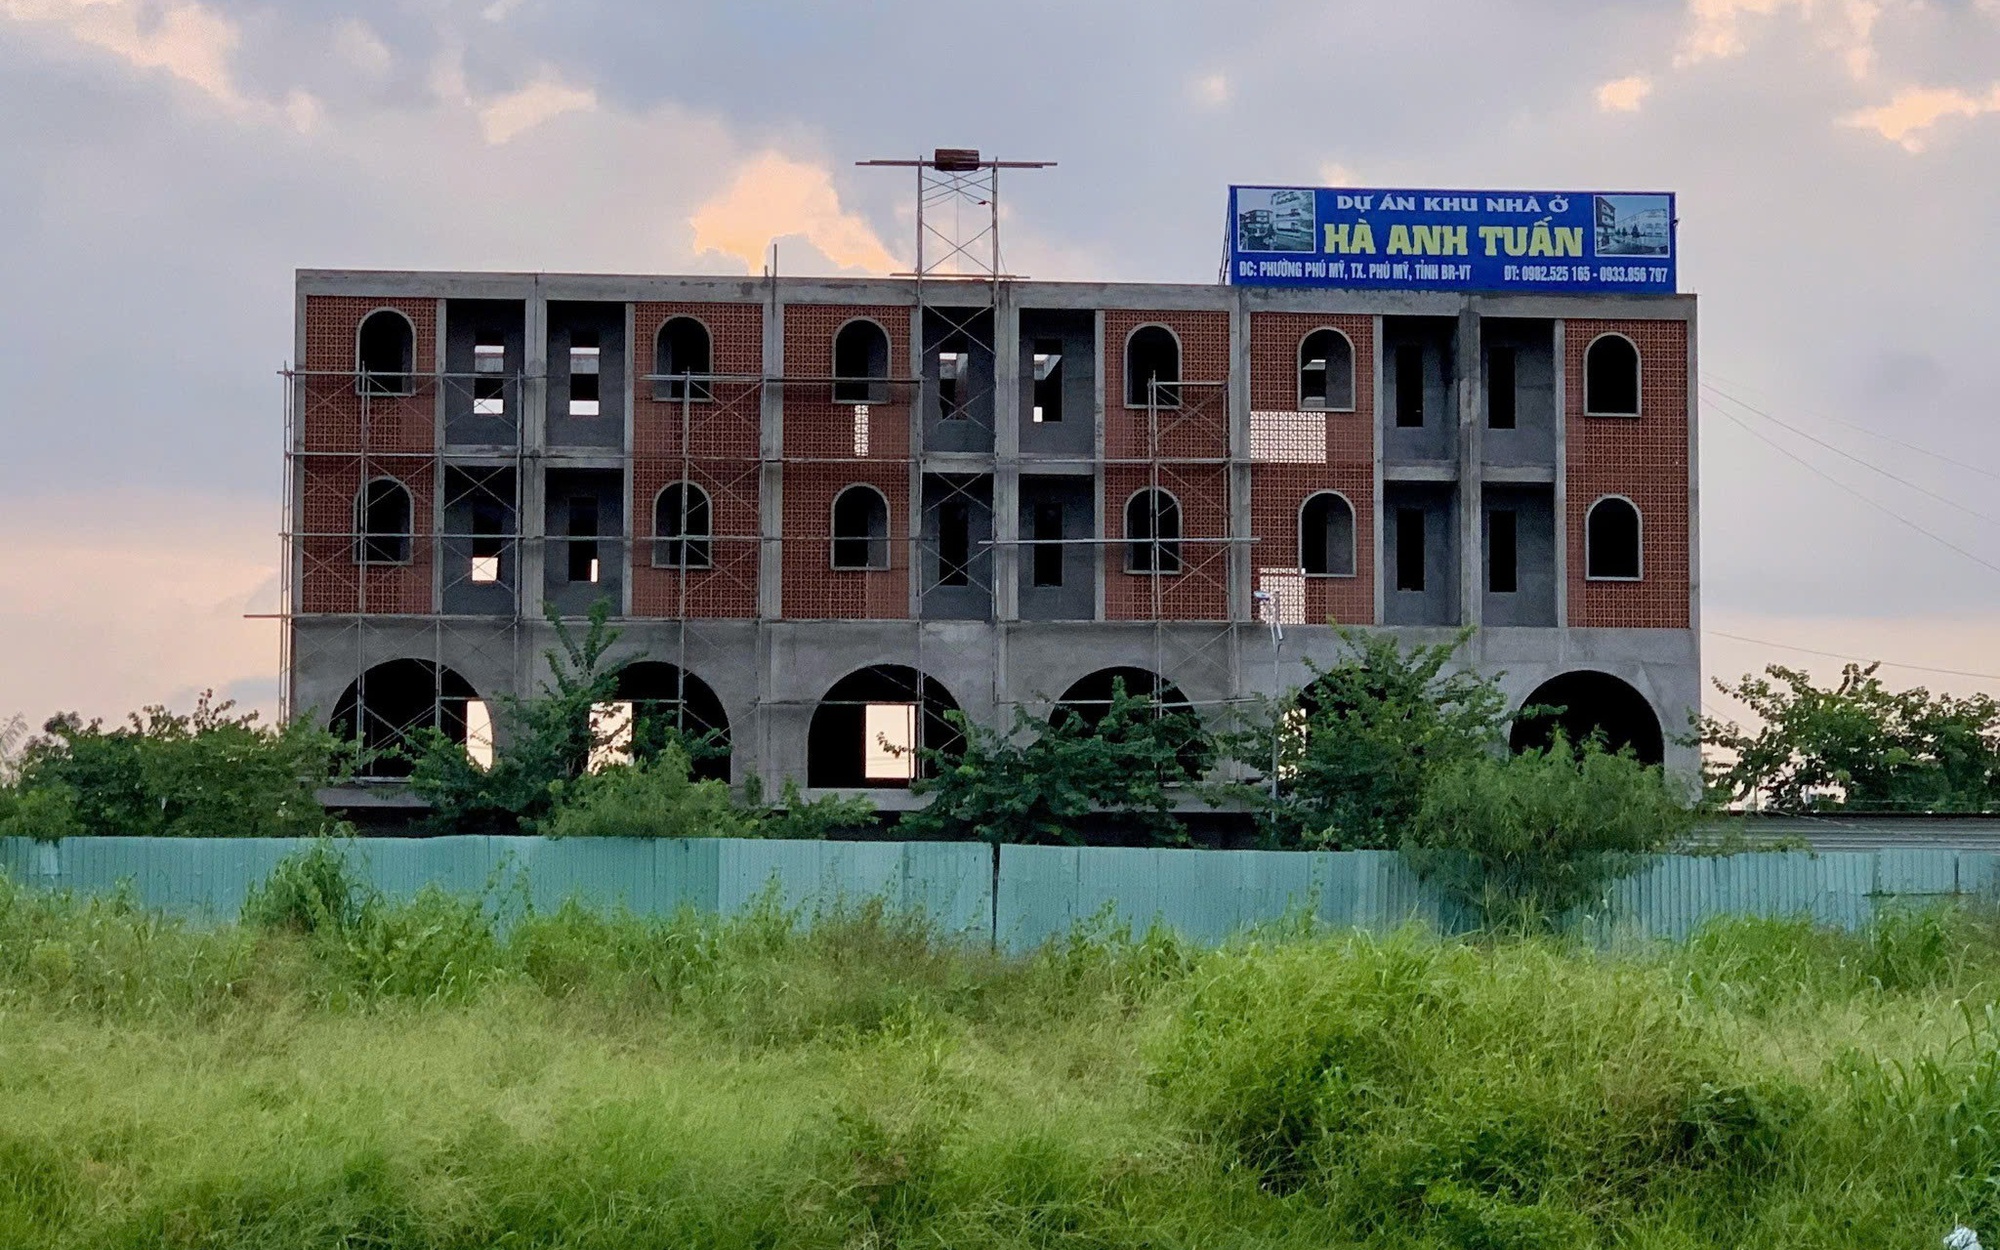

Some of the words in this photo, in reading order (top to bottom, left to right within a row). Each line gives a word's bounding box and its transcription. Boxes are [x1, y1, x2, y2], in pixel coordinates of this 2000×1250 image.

[1337, 195, 1373, 212] DỰ
[1378, 193, 1416, 211] ÁN
[1424, 197, 1478, 212] KHU
[1486, 197, 1541, 213] NHÀ
[1548, 194, 1569, 213] Ở
[1324, 218, 1376, 254] HÀ
[1386, 224, 1468, 255] ANH
[1478, 216, 1583, 257] TUẤN
[1260, 258, 1302, 277] PHƯỜNG
[1305, 259, 1326, 278] PHÚ
[1351, 263, 1366, 279] TX.
[1369, 261, 1390, 279] PHÚ
[1415, 259, 1439, 280] TỈNH
[1441, 264, 1471, 280] BR-VT
[1571, 266, 1590, 281] 165
